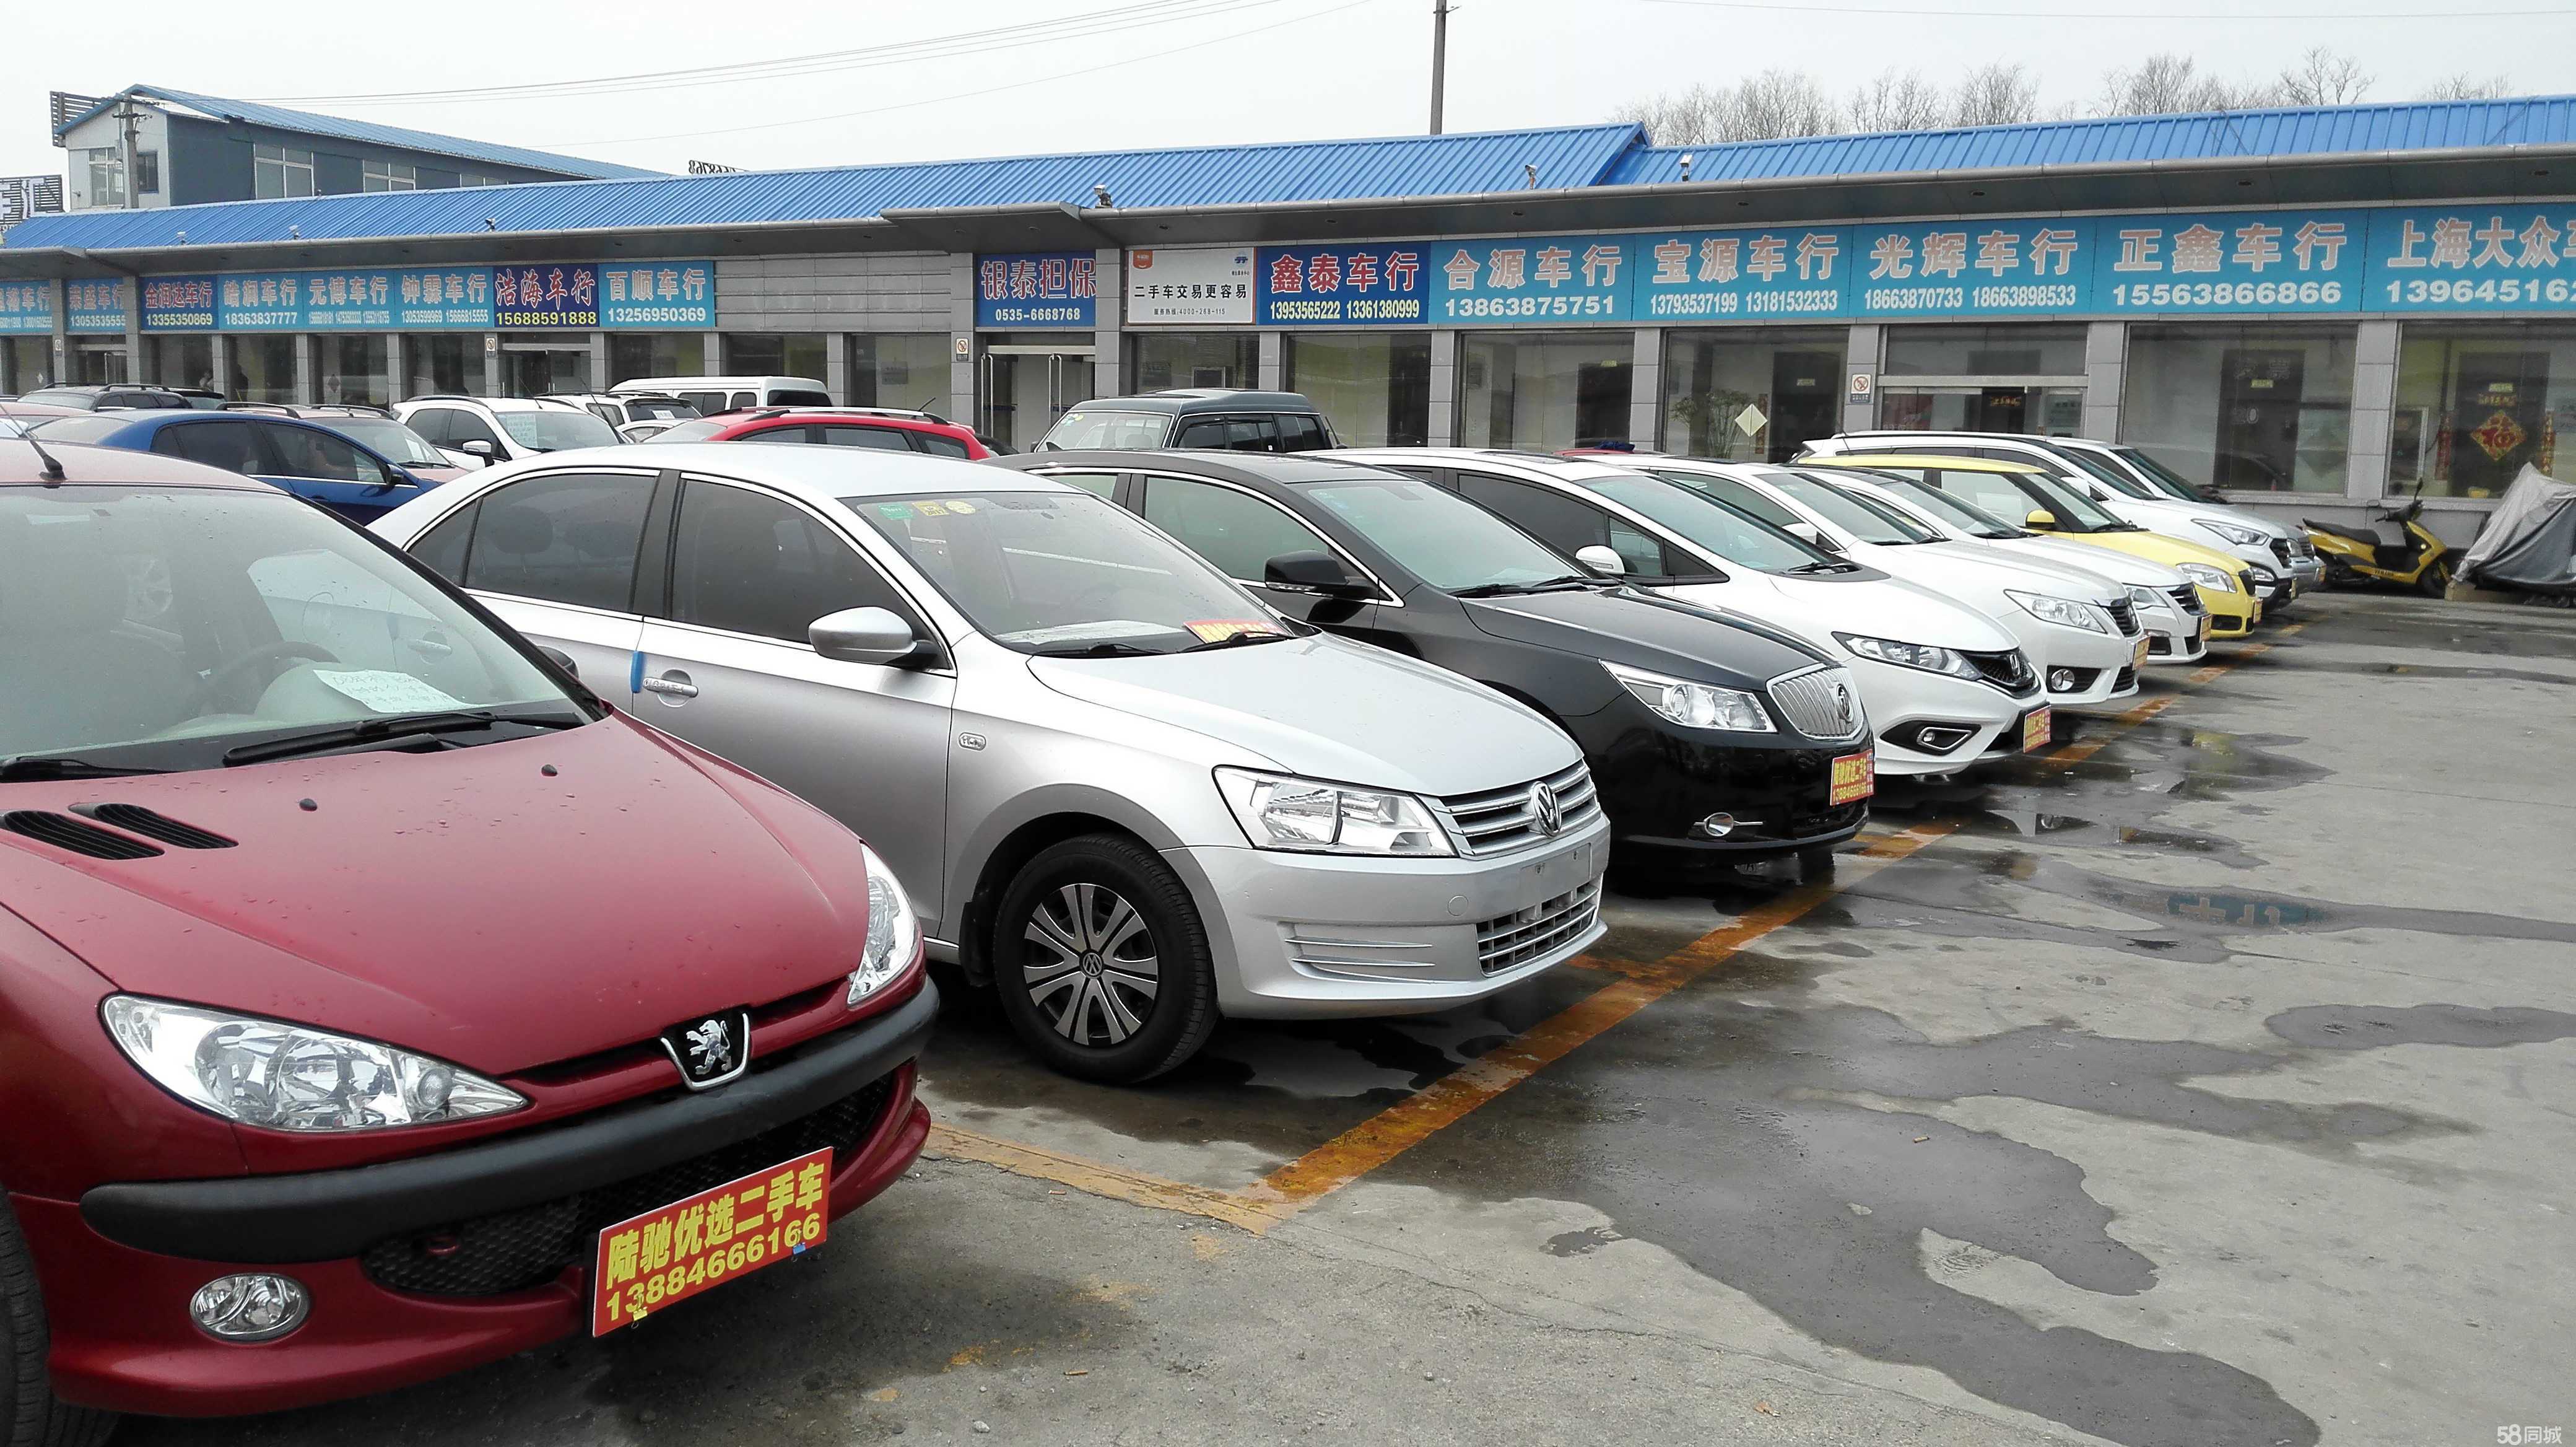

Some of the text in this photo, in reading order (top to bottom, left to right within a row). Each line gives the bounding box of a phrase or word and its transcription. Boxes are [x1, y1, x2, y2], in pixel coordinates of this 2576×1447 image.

[1653, 233, 1838, 284] 宝源车行
[1869, 228, 2078, 279] 光辉车行
[2113, 221, 2348, 273] 正鑫车行
[981, 258, 1095, 300] 银泰担保
[1271, 251, 1418, 293] 鑫泰车行
[1443, 243, 1622, 290] 合源车行
[145, 281, 212, 308] 金润达车行
[495, 268, 595, 310] 浩海车行
[606, 268, 705, 301] 百顺车行
[1134, 284, 1247, 299] 二手车交易更容易
[2113, 281, 2342, 305] 15563866866
[2387, 279, 2576, 302] 13964516
[1271, 300, 1419, 319] 13953565222 13361380999
[1445, 295, 1613, 317] 13863875751
[1650, 290, 1838, 315] 13793537199 13181532333
[1865, 285, 2076, 310] 18663870733 18663898533
[147, 313, 212, 326] 13355350869
[225, 312, 297, 325] 18363837777
[496, 312, 596, 325] 15688591888
[608, 308, 706, 321] 13256950369
[996, 308, 1081, 321] 0535-6668768
[606, 1162, 824, 1290] 陆驰优选二手车
[606, 1212, 820, 1321] 13884666166
